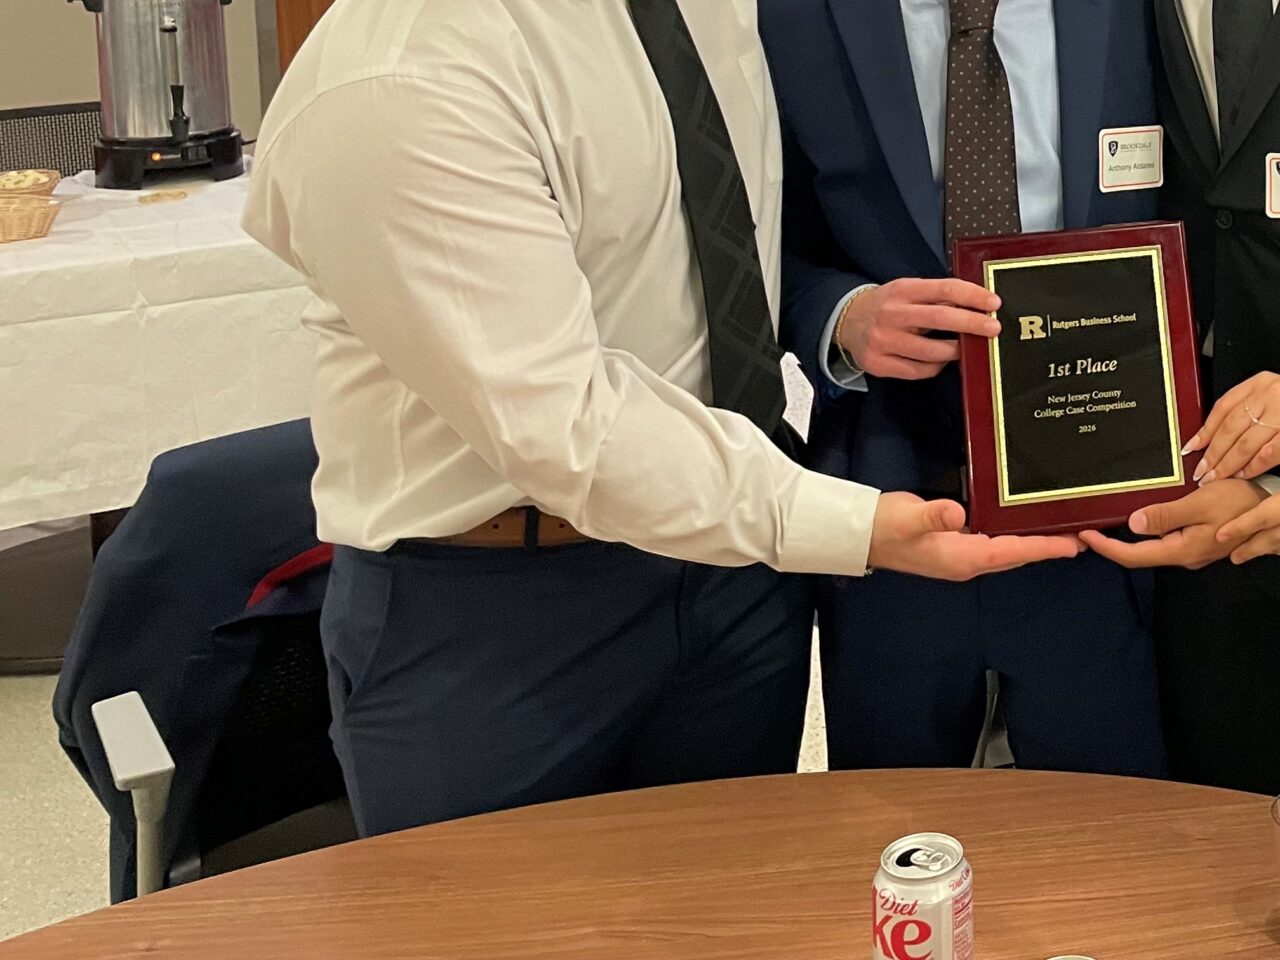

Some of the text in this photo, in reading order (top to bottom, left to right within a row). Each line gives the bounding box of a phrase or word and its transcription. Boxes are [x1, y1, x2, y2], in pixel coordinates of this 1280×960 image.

[1019, 316, 1046, 340] R
[1052, 313, 1137, 330] Rutgers Business School
[1048, 358, 1118, 378] 1st Place
[1047, 390, 1122, 404] New Jersey County
[1033, 401, 1137, 419] College Case Competition
[1078, 424, 1097, 433] 2026
[879, 888, 919, 916] Diet
